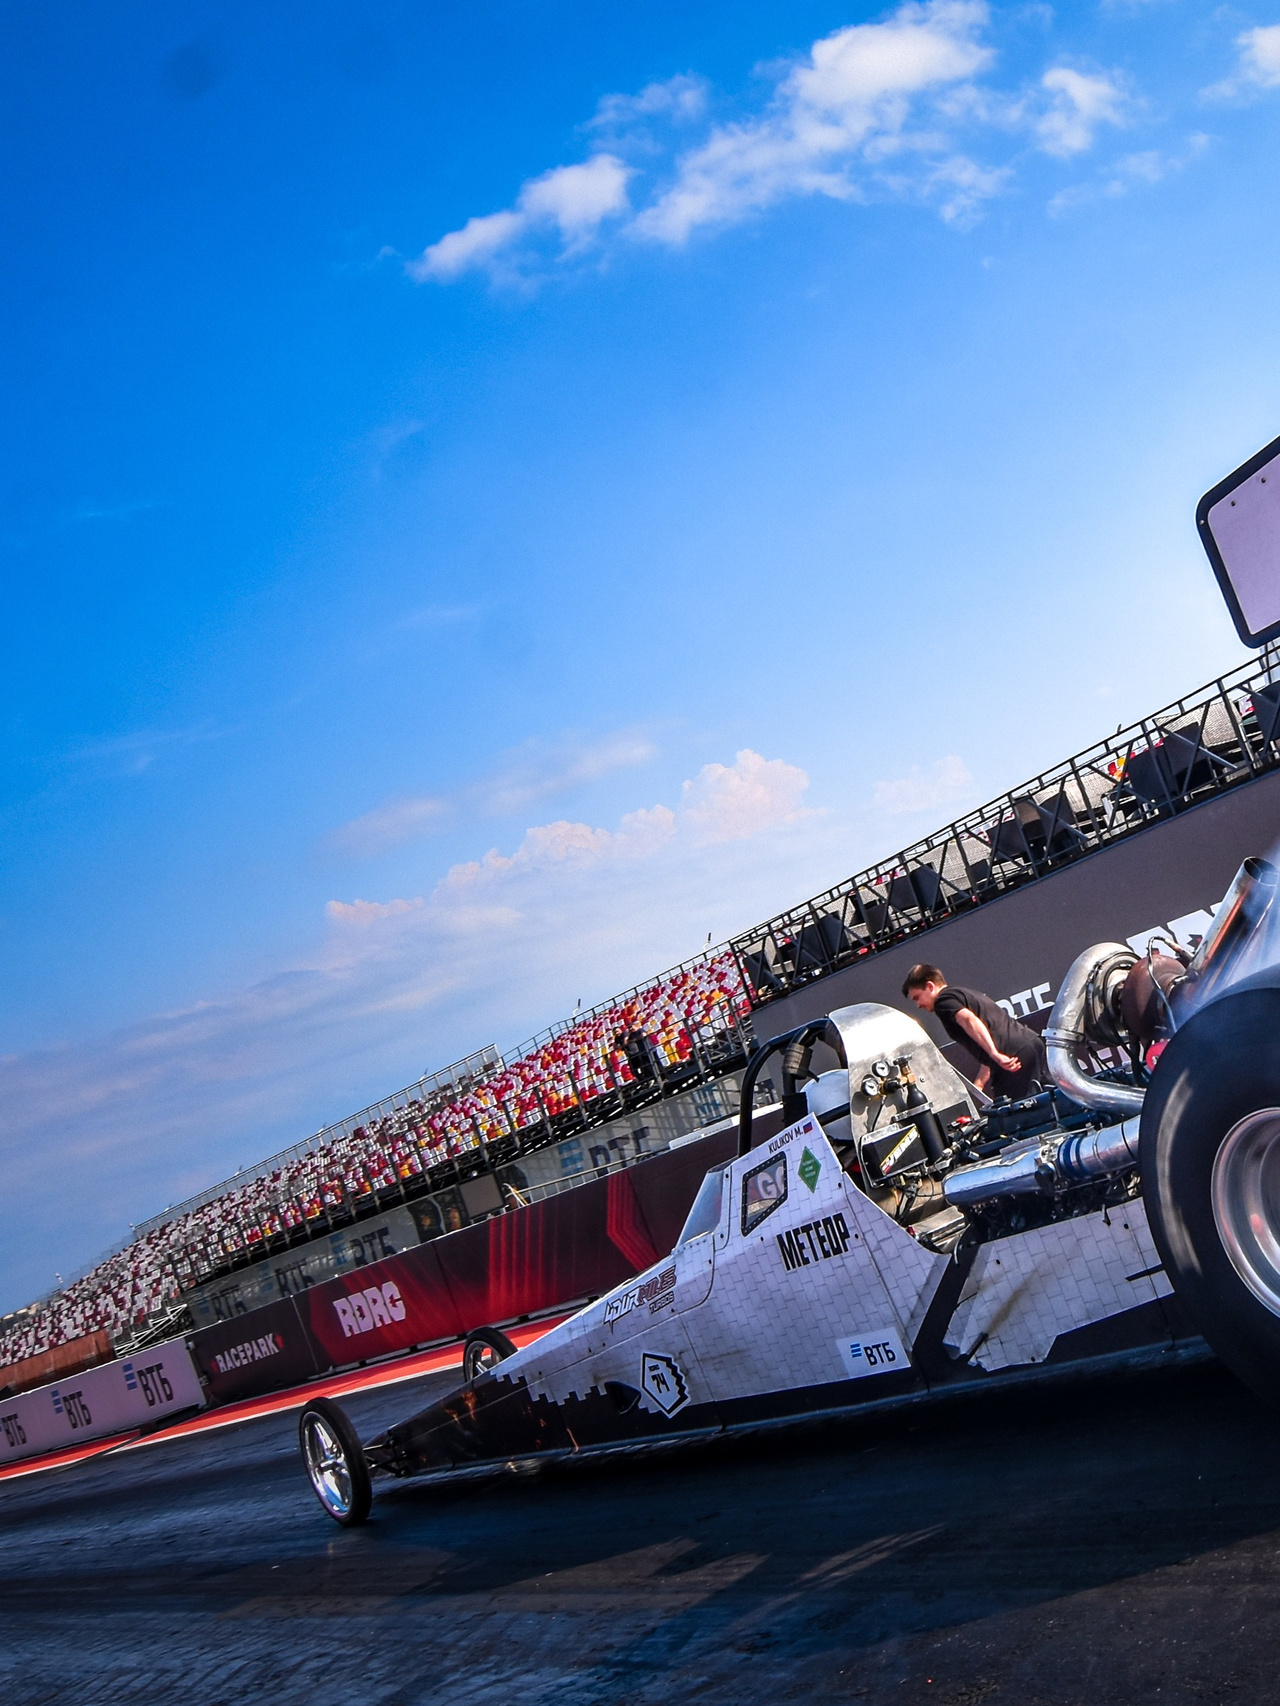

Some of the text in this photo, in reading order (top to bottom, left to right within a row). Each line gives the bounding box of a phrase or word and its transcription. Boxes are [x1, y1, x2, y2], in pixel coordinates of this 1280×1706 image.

[768, 1131, 794, 1155] KULIKOV
[776, 1212, 851, 1272] МЕТЕОР
[332, 1280, 407, 1338] RDRC
[649, 1290, 675, 1315] TURBOS
[214, 1332, 280, 1374] RACEPARK
[863, 1341, 896, 1366] ВТБ
[136, 1362, 174, 1407] ВТБ
[651, 1372, 671, 1394] 74
[62, 1390, 92, 1430] ВТБ
[1, 1413, 28, 1448] ВТБ
